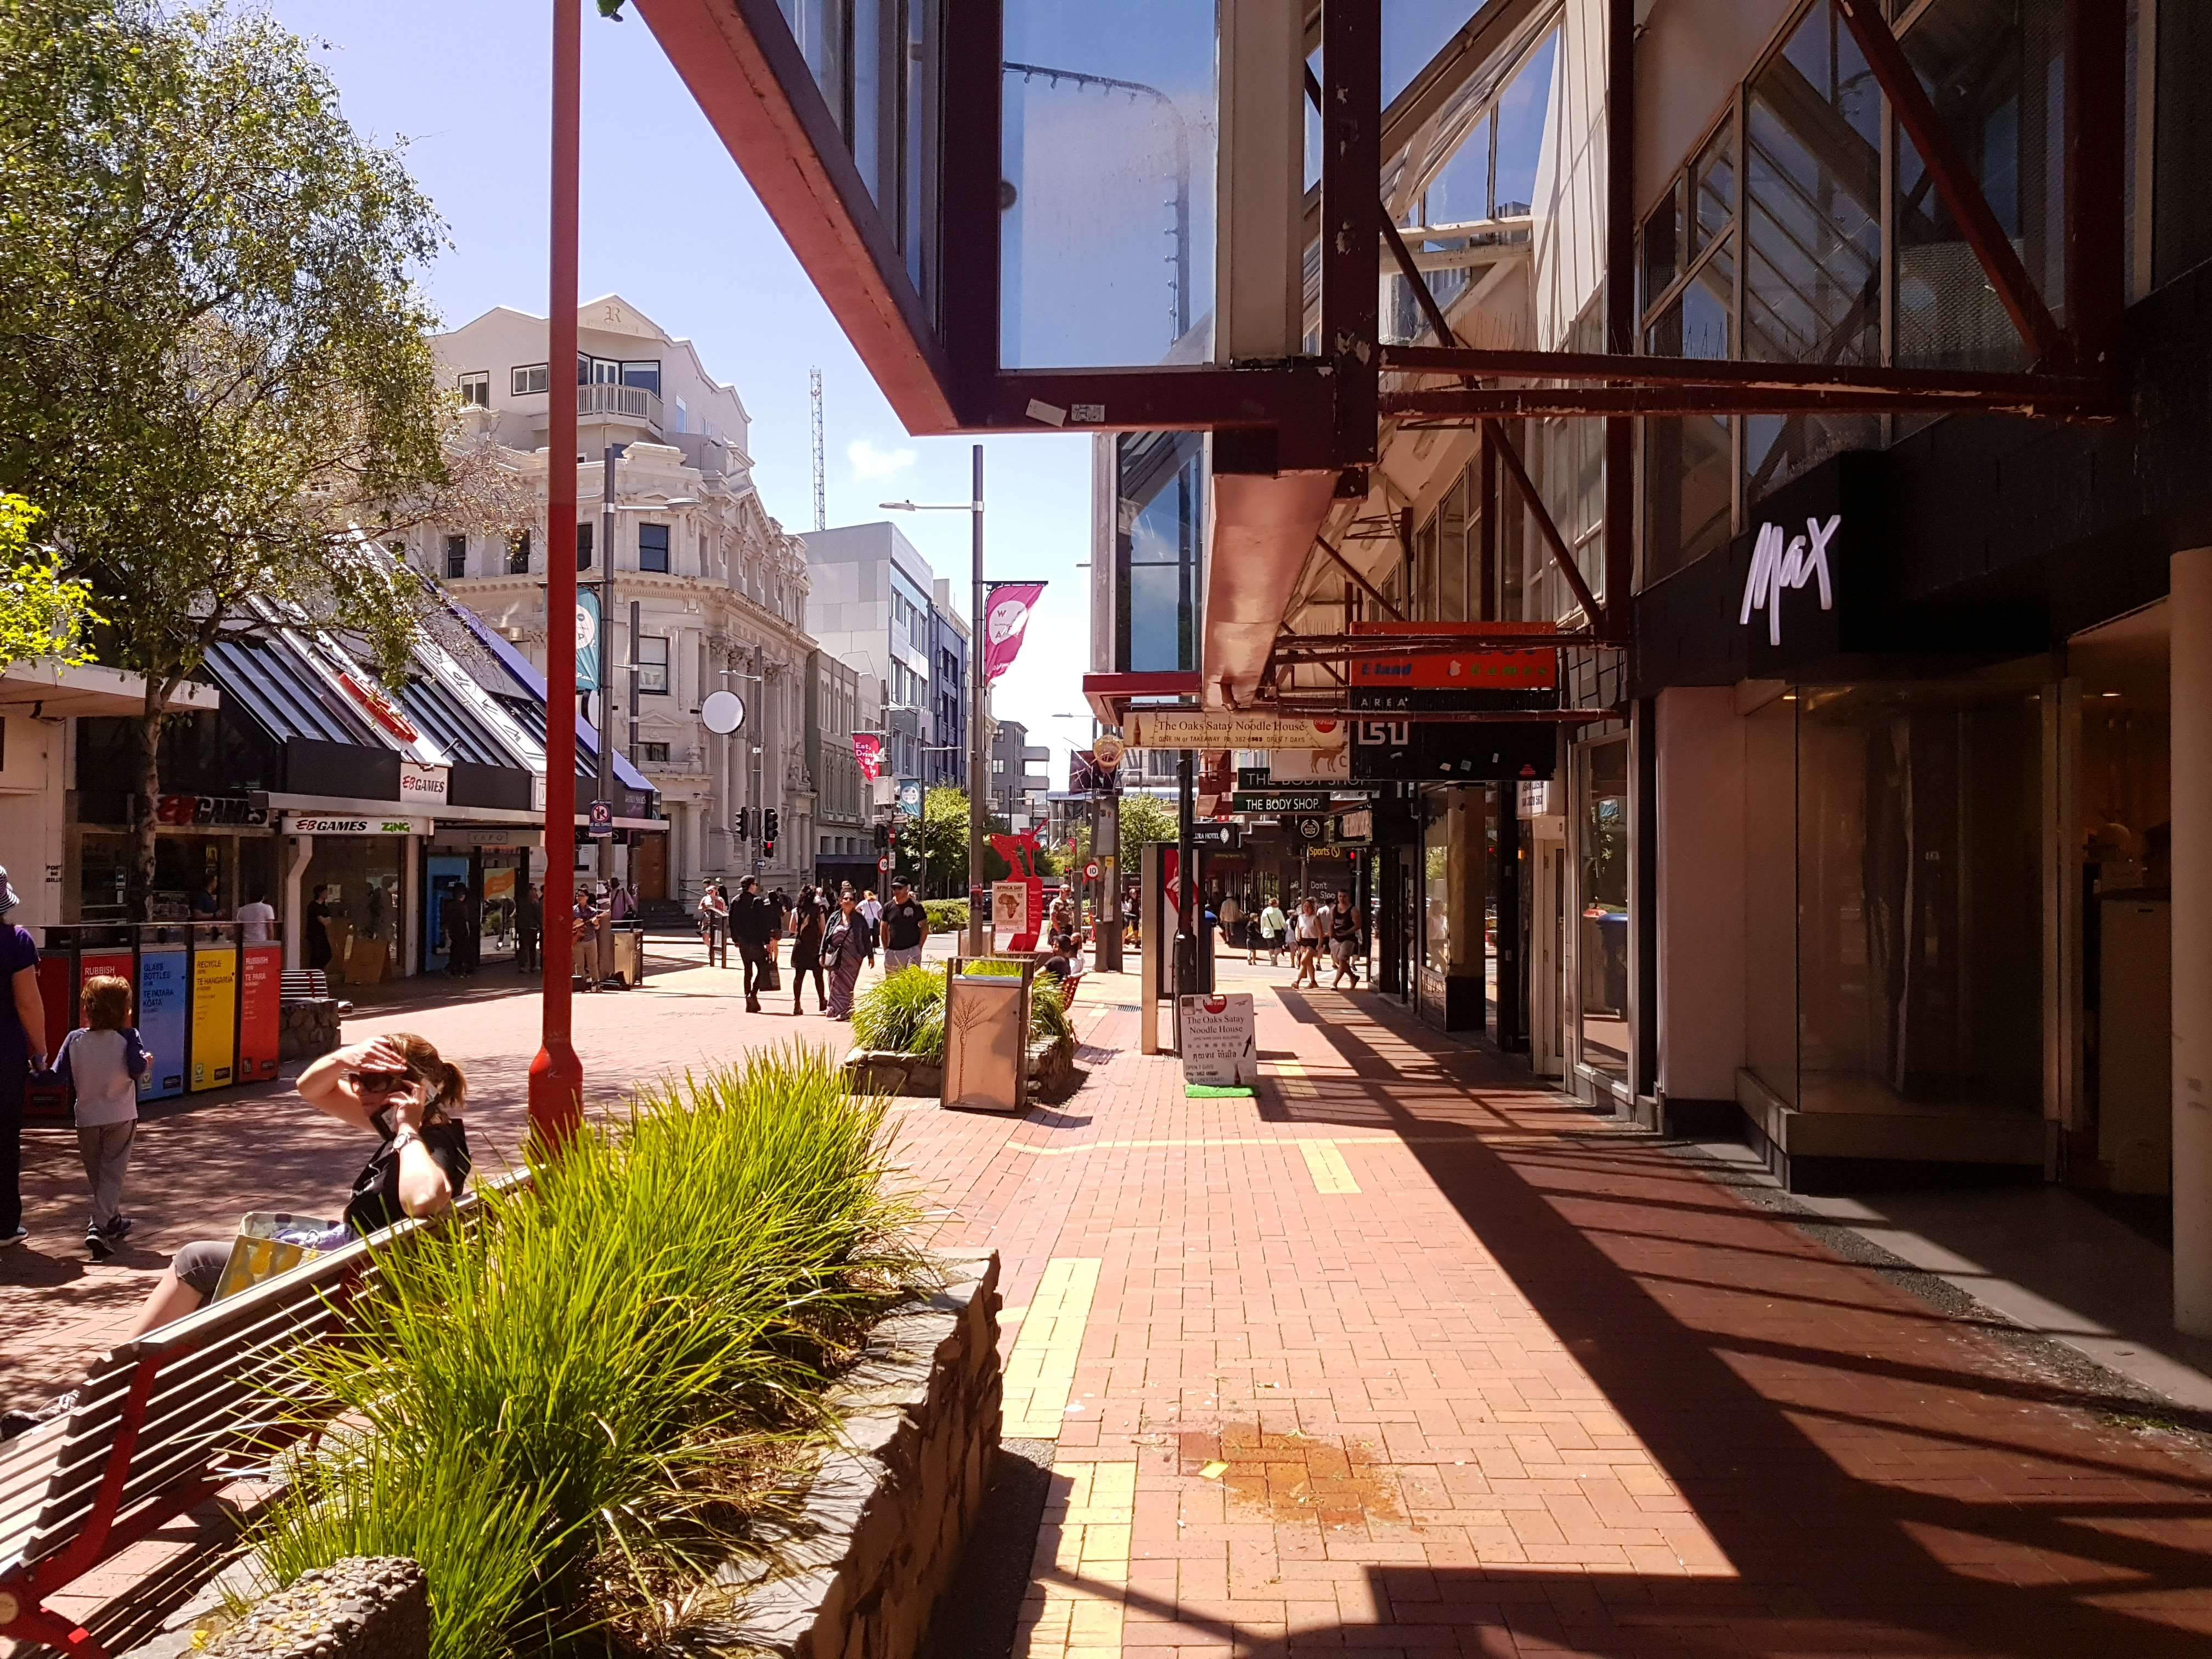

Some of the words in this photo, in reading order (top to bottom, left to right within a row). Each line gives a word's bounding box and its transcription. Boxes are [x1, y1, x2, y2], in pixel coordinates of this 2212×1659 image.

[1361, 698, 1406, 707] AREA
[1158, 721, 1177, 730] The
[1179, 721, 1204, 730] Oaks
[1206, 721, 1233, 731] Satay
[1235, 721, 1271, 730] Noodle
[1274, 721, 1305, 730] House
[855, 742, 871, 751] Eat,
[403, 775, 415, 791] EB
[415, 778, 445, 793] GAMES
[1245, 799, 1263, 810] THE
[1266, 798, 1292, 810] BODY
[296, 820, 317, 831] EB
[317, 821, 368, 831] GAMES
[1309, 846, 1330, 857] Sports
[1311, 881, 1327, 889] Don't
[196, 960, 222, 969] RECYCLE
[245, 956, 268, 965] RUBBISH
[84, 966, 115, 976] RUBBISH
[144, 962, 164, 972] GLASS
[143, 971, 171, 980] BOTTLES
[245, 973, 252, 982] TE
[252, 972, 267, 981] PARA
[143, 990, 151, 998] TE
[1203, 1015, 1222, 1024] Oaks
[1224, 1015, 1245, 1024] Satay
